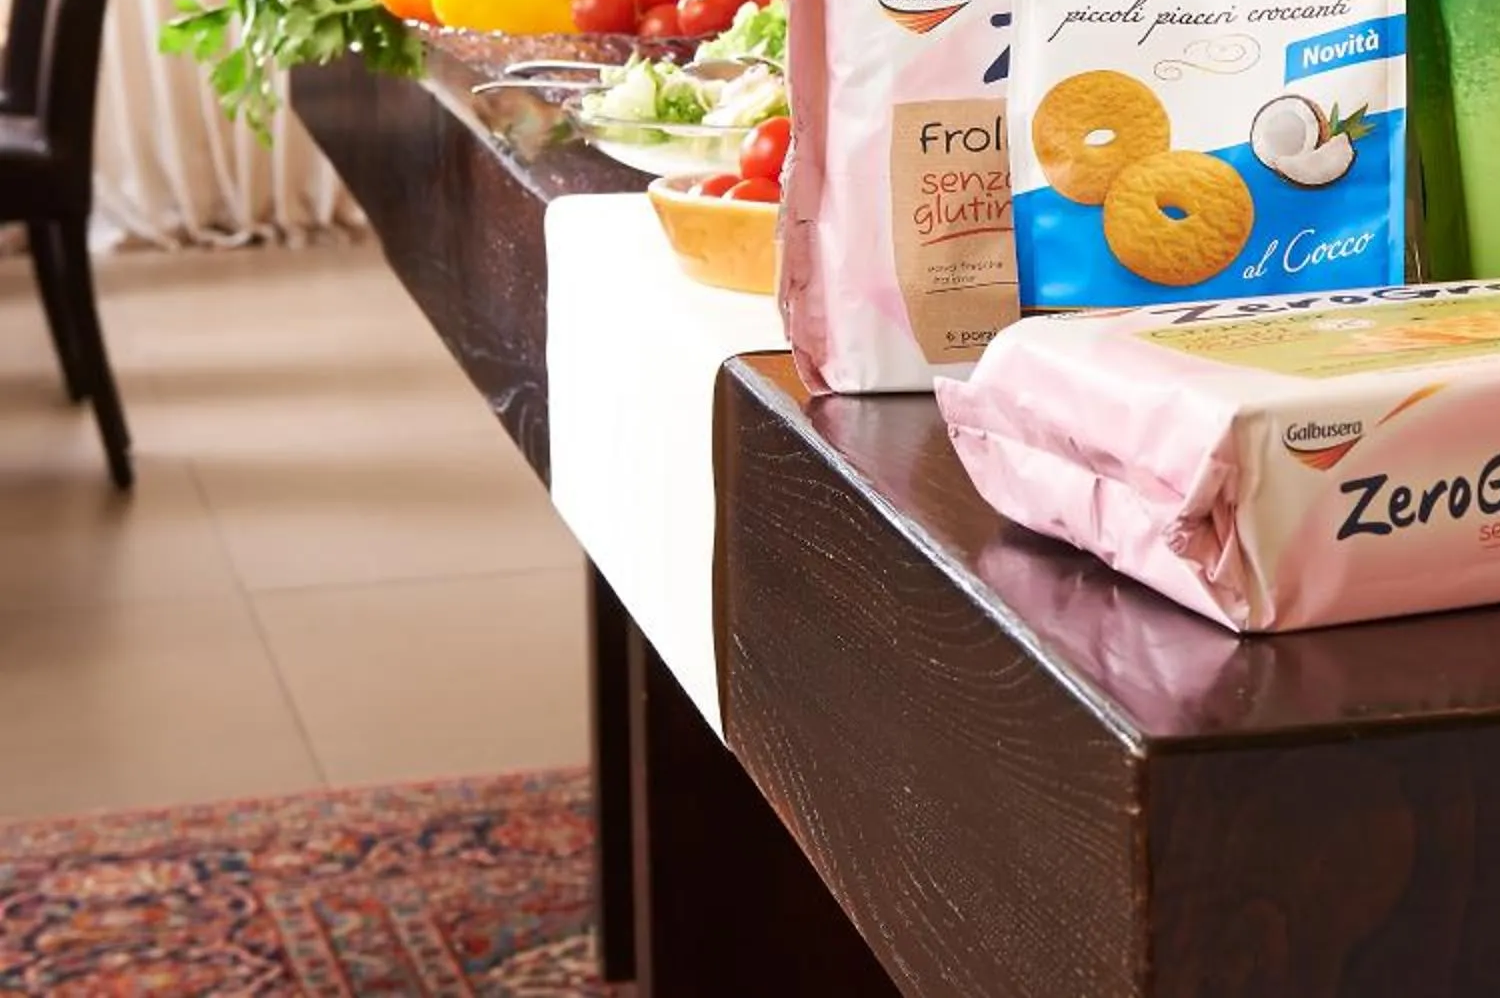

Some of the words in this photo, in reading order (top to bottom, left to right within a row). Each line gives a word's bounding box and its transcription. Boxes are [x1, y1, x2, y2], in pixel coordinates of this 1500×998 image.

[1302, 29, 1380, 69] Novità
[1242, 239, 1279, 281] al
[1282, 228, 1376, 274] Cocco
[1286, 420, 1363, 442] Galbusera
